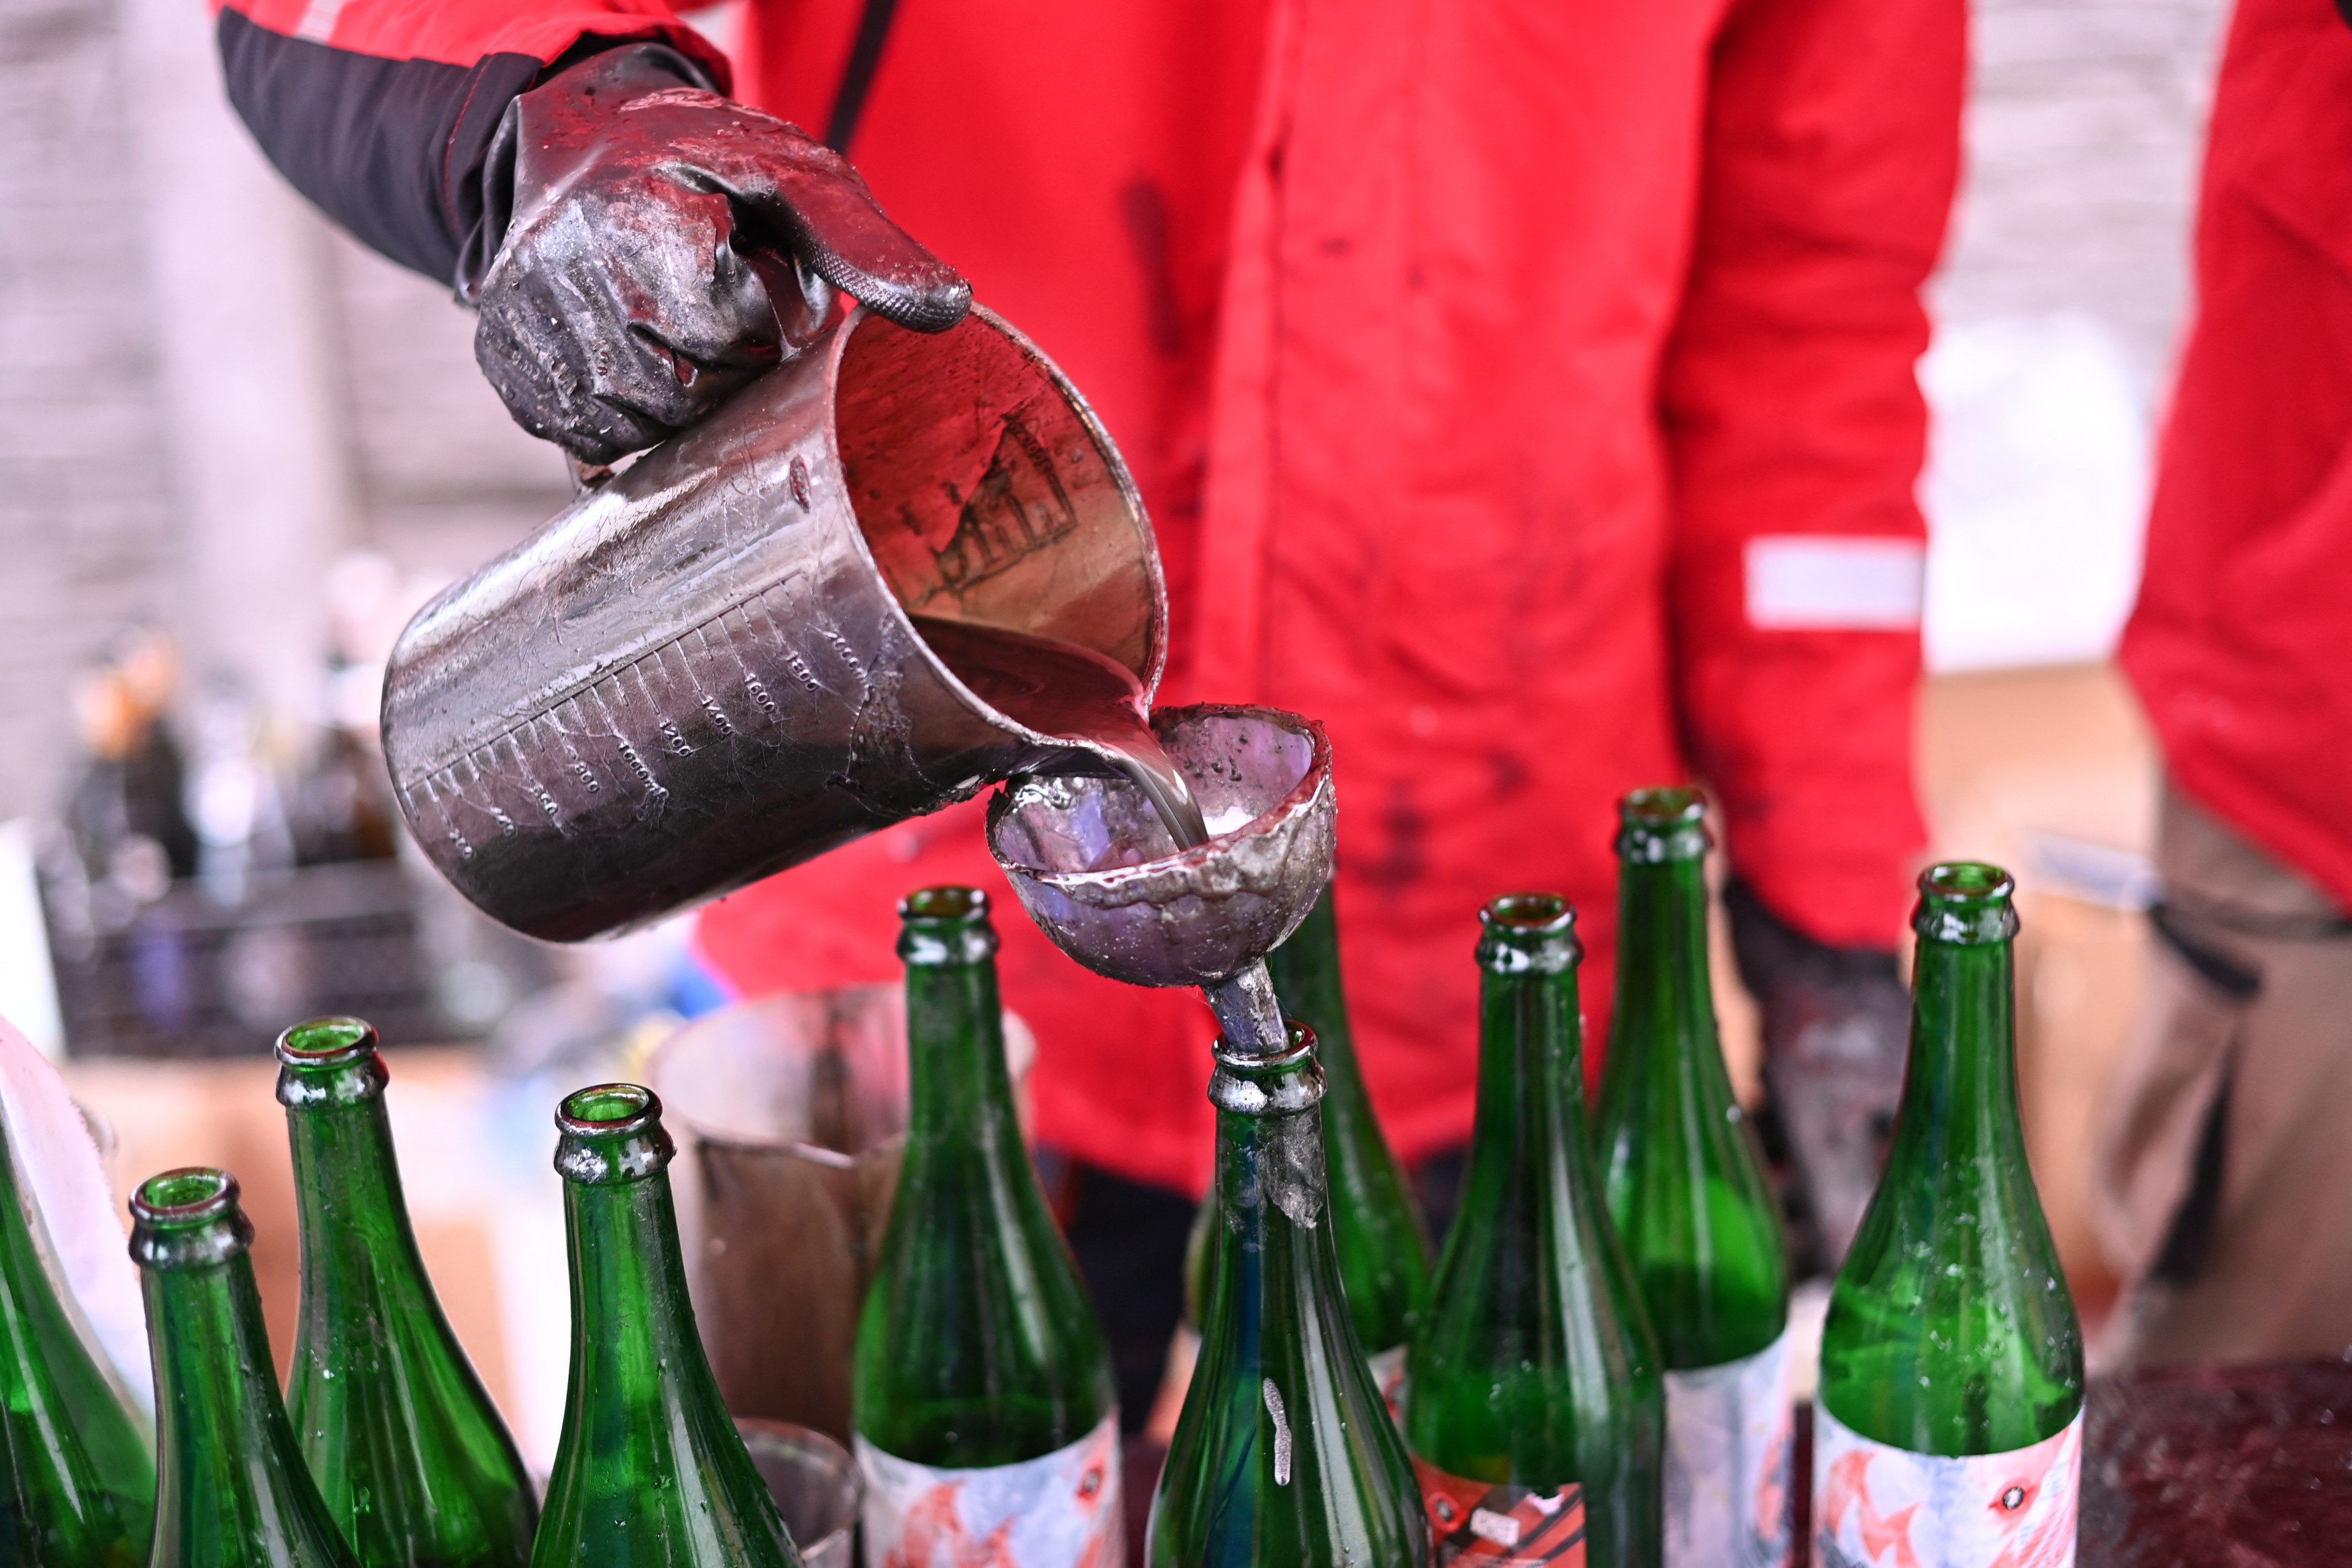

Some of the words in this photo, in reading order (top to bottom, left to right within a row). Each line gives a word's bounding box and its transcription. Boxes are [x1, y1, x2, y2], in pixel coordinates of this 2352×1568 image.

[786, 650, 817, 691] 1800
[744, 673, 776, 713] 1600
[702, 695, 733, 735] 1400
[659, 718, 691, 757] 1200
[575, 761, 600, 793] 800
[618, 740, 649, 779] 1000
